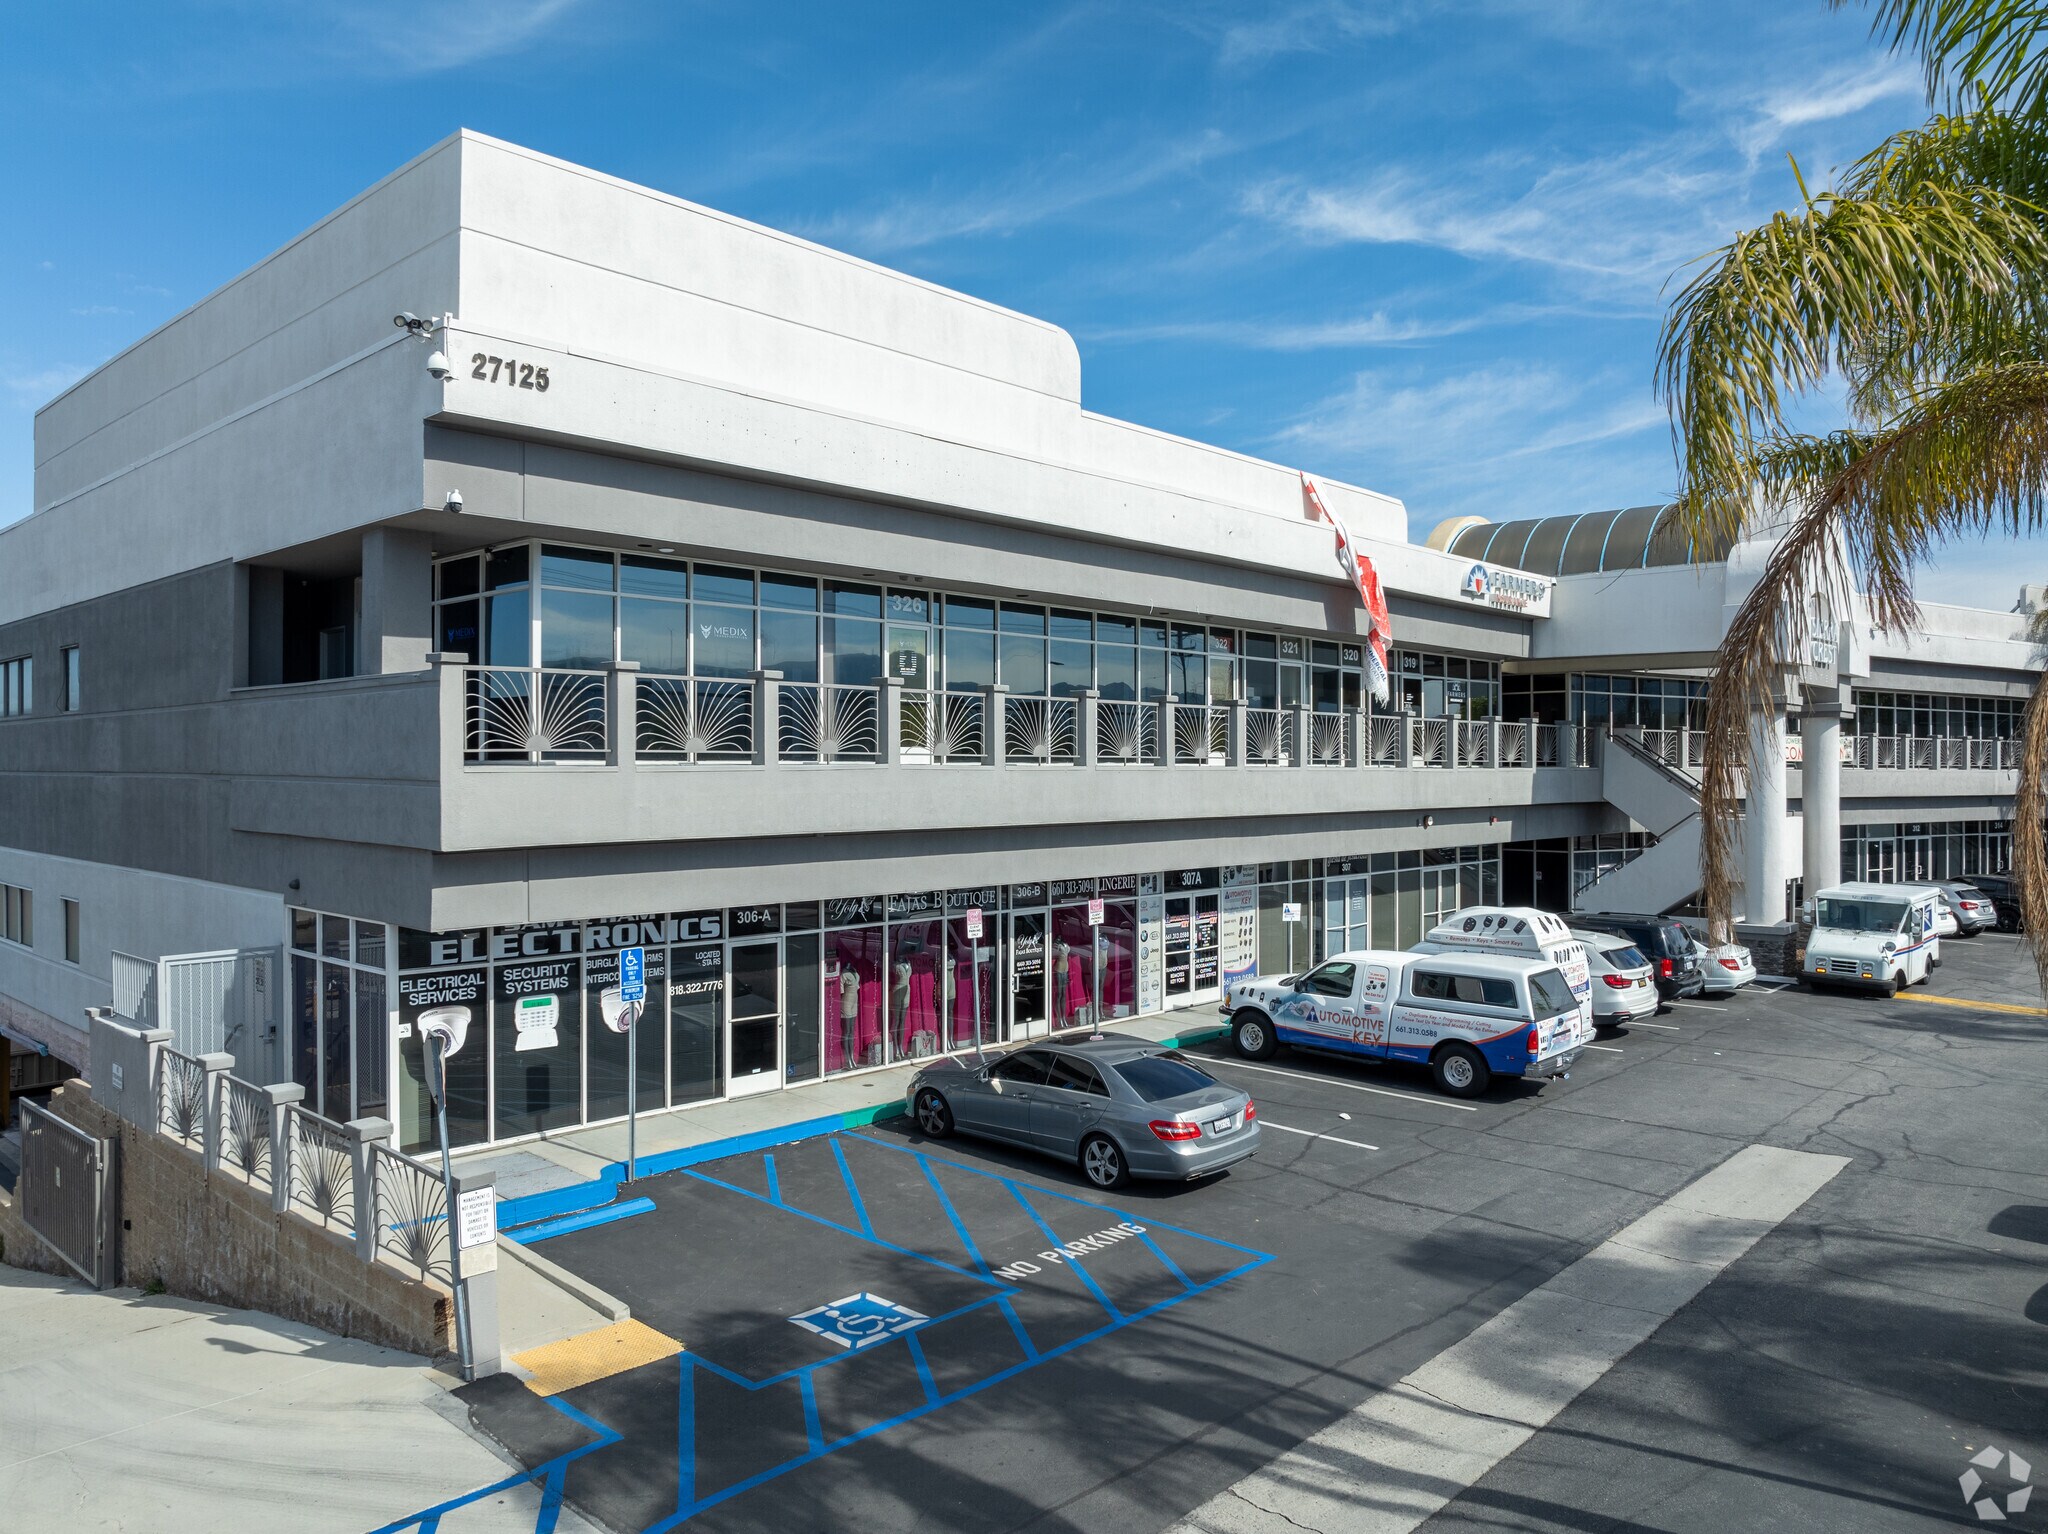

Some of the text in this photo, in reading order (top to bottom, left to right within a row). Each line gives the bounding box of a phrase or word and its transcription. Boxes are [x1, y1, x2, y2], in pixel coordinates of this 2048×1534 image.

[471, 353, 550, 392] 27125
[1494, 572, 1545, 598] FARMERS
[892, 595, 922, 614] 326
[714, 626, 747, 637] MEDIX
[1215, 637, 1228, 650] 322
[1282, 640, 1298, 655] 321
[1343, 648, 1359, 662] 320
[1812, 642, 1837, 665] CREST
[1404, 656, 1416, 669] 319
[1097, 875, 1136, 892] LINGERIE
[1181, 872, 1202, 885] 307A
[1017, 886, 1041, 897] 306-B
[1065, 880, 1094, 895] 313-5094
[933, 890, 996, 909] BOUTIQUE
[737, 911, 771, 924] 306-A
[430, 915, 721, 966] ELECTRONICS
[695, 950, 721, 960] LOCATED
[586, 957, 620, 970] BURGLA
[503, 963, 571, 981] SECURITY
[586, 973, 620, 985] NTERCO
[400, 973, 486, 993] ELECTRICAL
[505, 976, 569, 994] SYSTEMS
[669, 980, 724, 996] 818.322.7776
[409, 987, 477, 1006] SERVICES
[1305, 1006, 1385, 1033] AUTOMOTIVE
[1408, 1011, 1429, 1019] Duplicate
[1443, 1016, 1471, 1026] Programming
[1475, 1020, 1492, 1028] Cutting
[1353, 1030, 1382, 1048] KEY
[1395, 1025, 1438, 1038] 661.313.0588
[463, 1194, 485, 1202] MANAGEMENT
[469, 1200, 492, 1209] RESPONSIBLE
[992, 1222, 1147, 1281] NO PARKING
